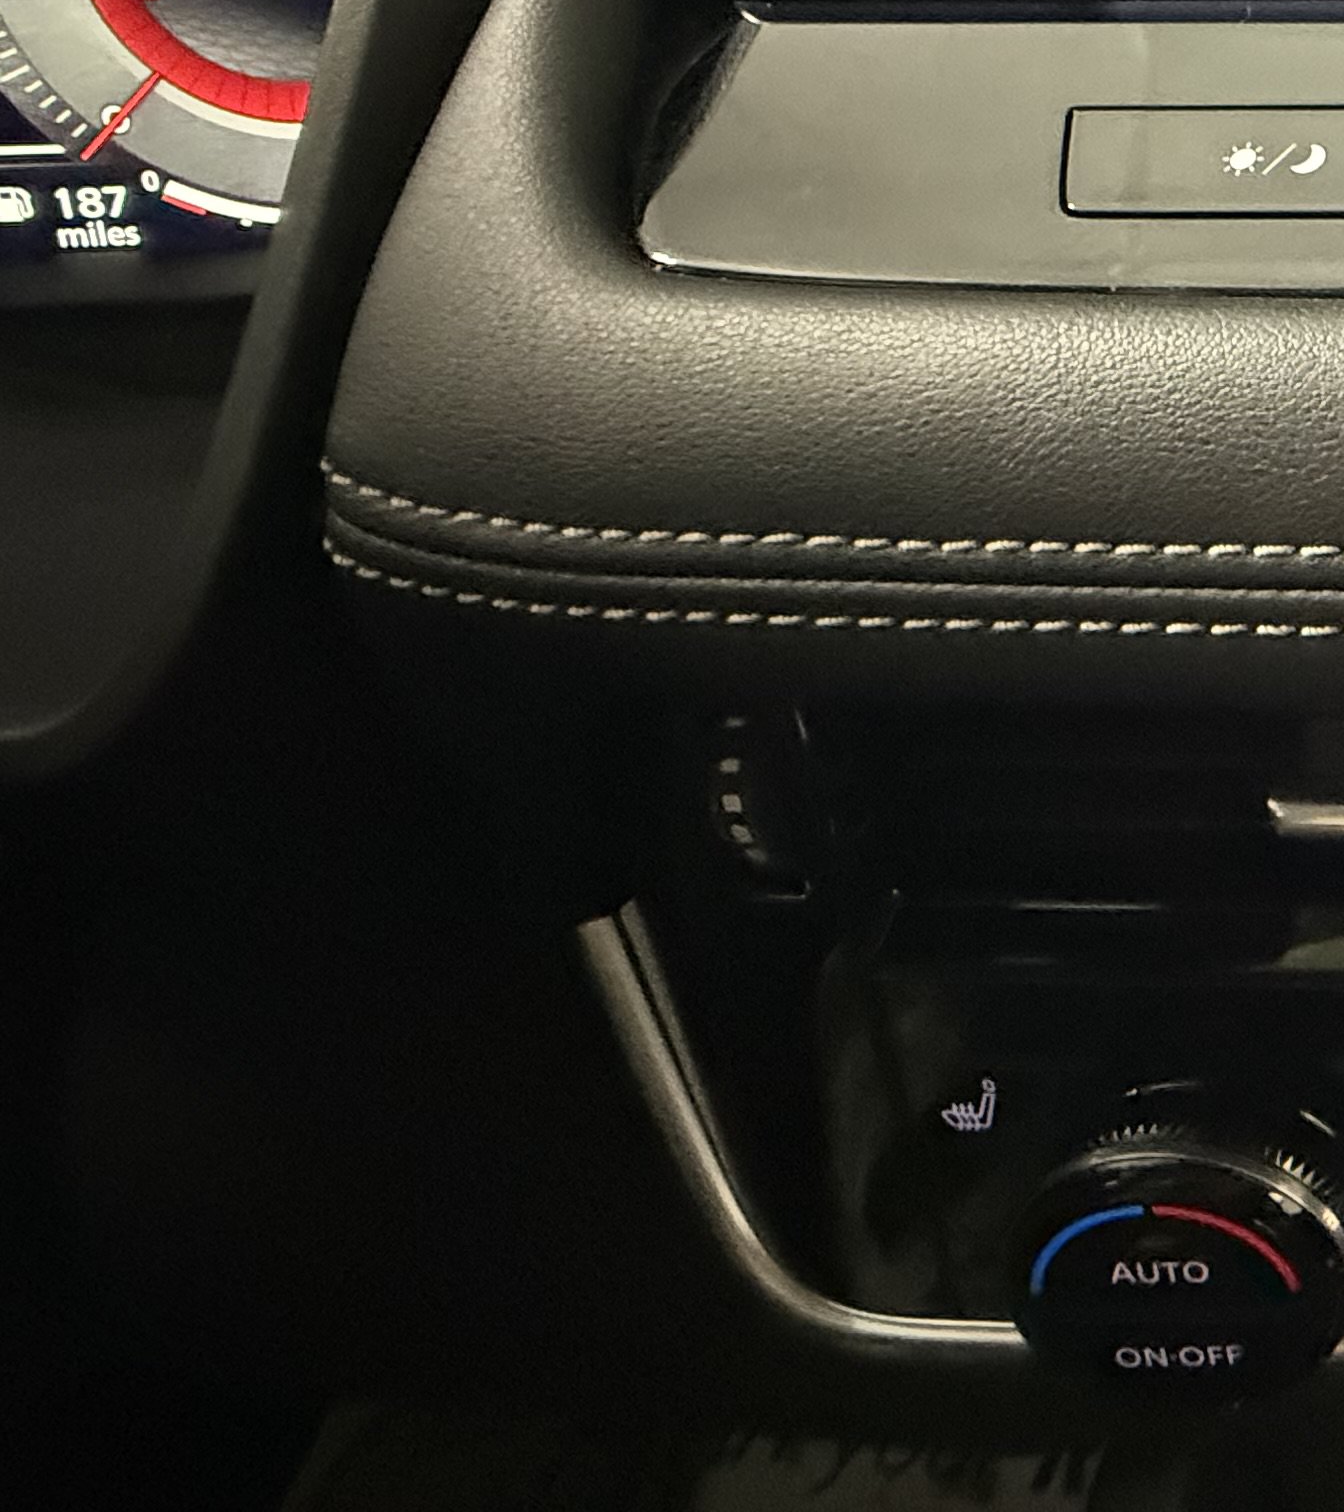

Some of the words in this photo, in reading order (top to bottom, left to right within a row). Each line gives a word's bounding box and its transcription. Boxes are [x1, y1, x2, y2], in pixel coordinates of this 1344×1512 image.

[140, 170, 160, 192] 0
[54, 186, 127, 220] 187
[56, 220, 142, 249] miles
[1111, 1261, 1210, 1285] AUTO
